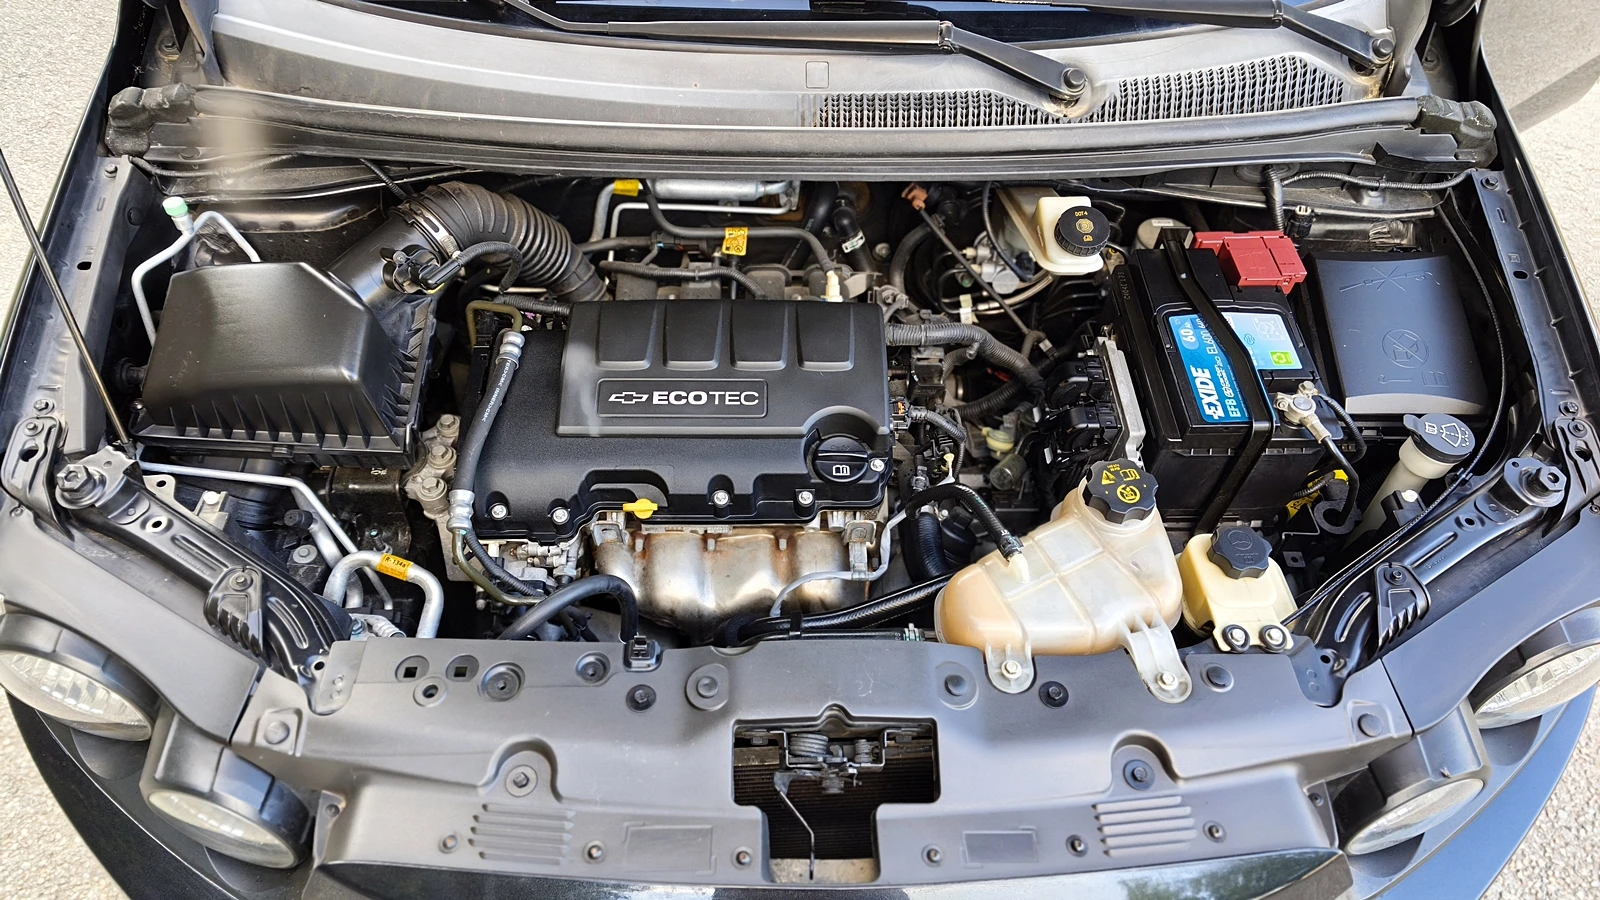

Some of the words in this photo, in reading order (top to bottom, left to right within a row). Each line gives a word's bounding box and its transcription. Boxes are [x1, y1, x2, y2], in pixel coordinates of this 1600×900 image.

[1180, 328, 1196, 343] 60
[652, 390, 760, 406] ECOTEC
[1190, 365, 1225, 421] EXIDE
[1225, 398, 1241, 418] EFB
[384, 556, 406, 568] R-134a
